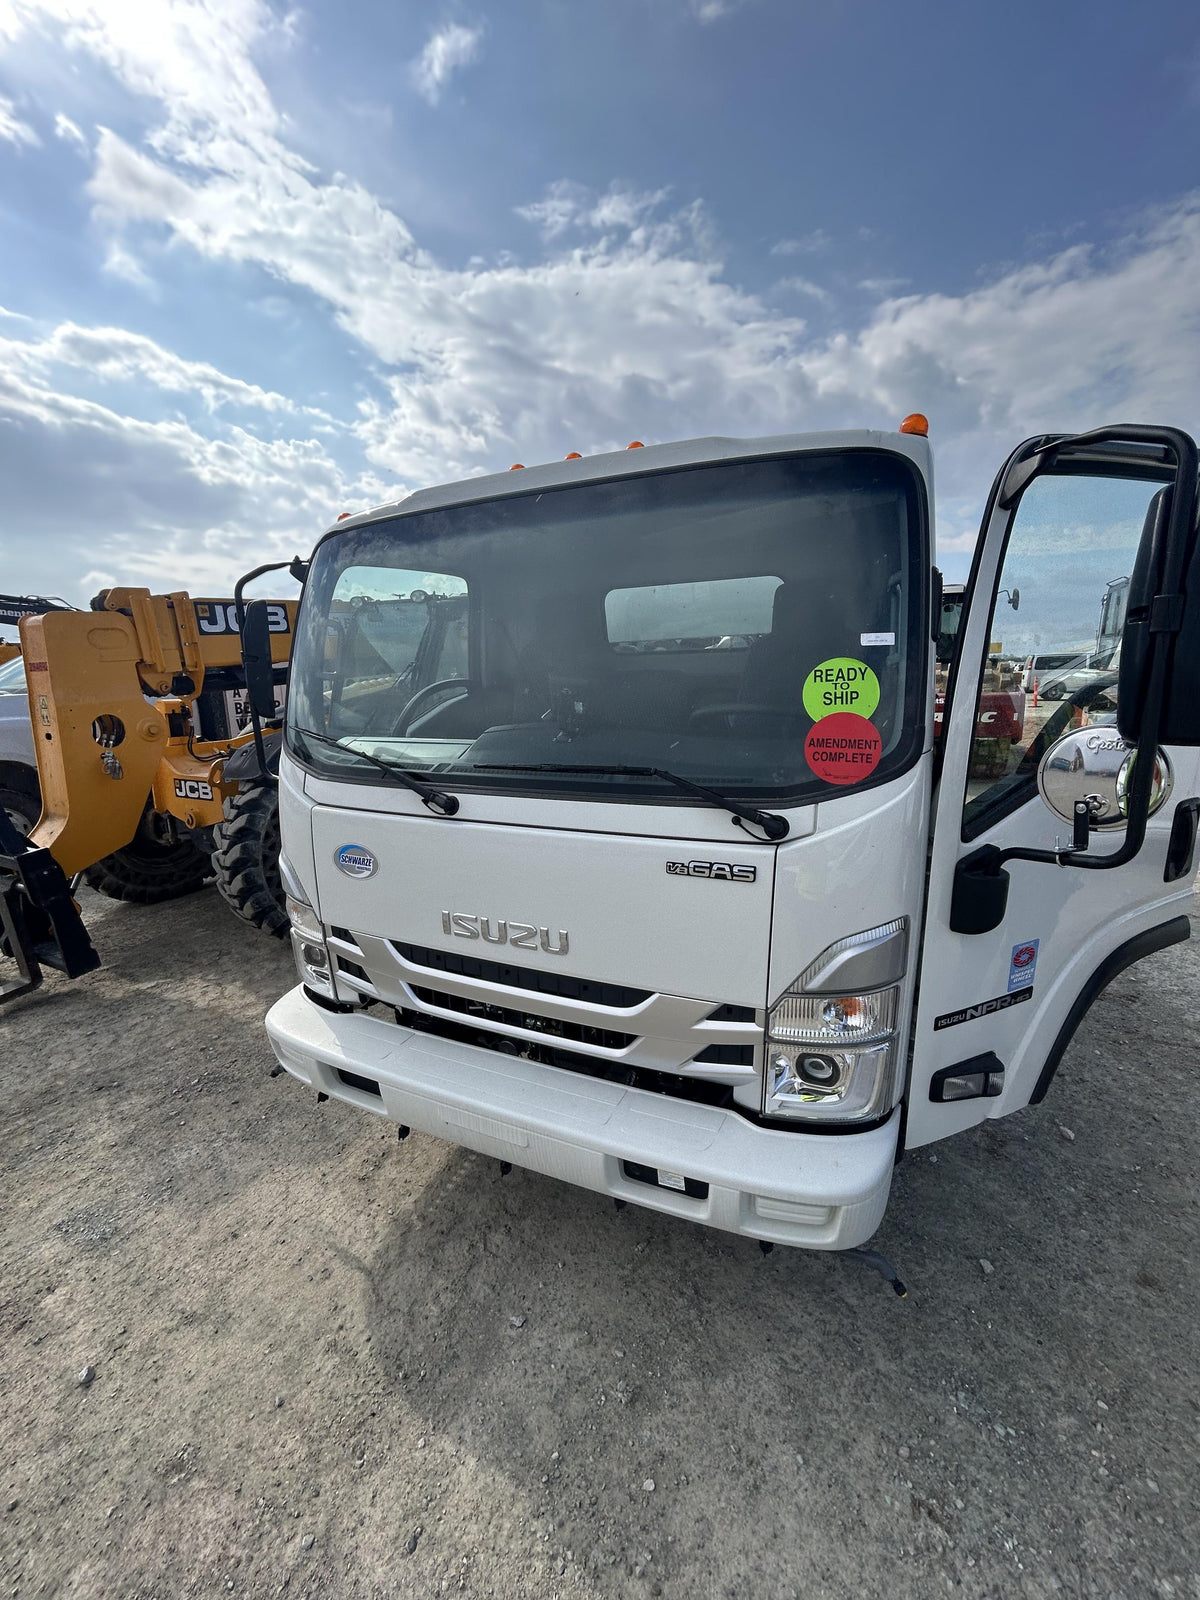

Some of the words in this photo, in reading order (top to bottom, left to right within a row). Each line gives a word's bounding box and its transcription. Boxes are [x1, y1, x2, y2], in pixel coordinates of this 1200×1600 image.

[813, 667, 868, 683] READY
[832, 682, 850, 690] TO
[823, 690, 860, 705] SHIP
[808, 738, 879, 750] AMENDMENT
[812, 751, 873, 764] COMPLETE
[175, 780, 212, 799] JCB
[340, 854, 372, 867] SCHWARZE
[688, 861, 756, 882] GAS
[442, 910, 569, 955] ISUZU
[938, 1013, 965, 1027] ISUZU
[965, 996, 1011, 1020] NPR
